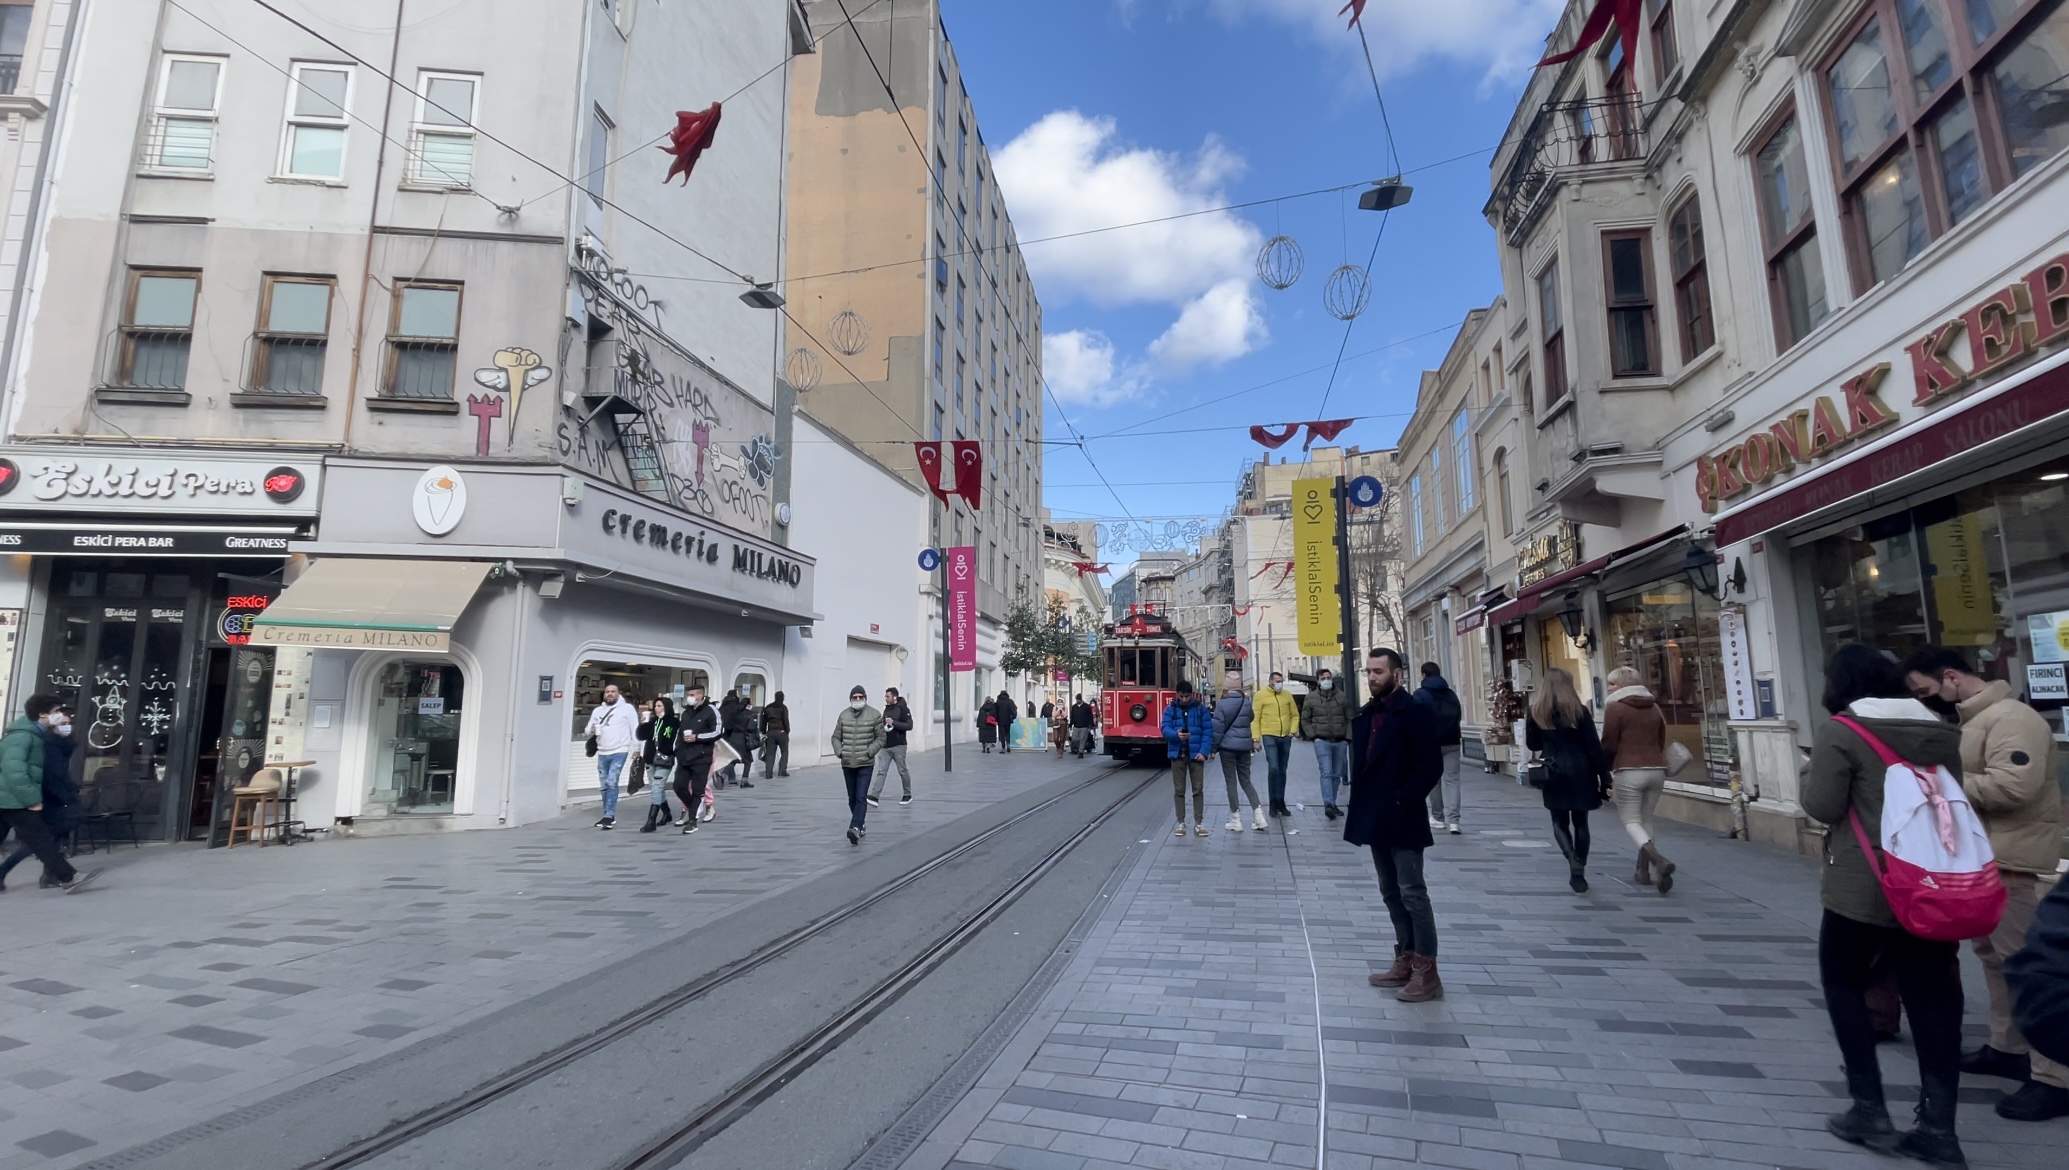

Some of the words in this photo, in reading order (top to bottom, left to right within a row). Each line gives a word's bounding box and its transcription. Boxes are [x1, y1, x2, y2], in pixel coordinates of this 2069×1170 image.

[1713, 361, 1900, 501] KONAK
[1804, 474, 1855, 512] KONAK
[1869, 443, 1925, 485] KEBAP
[1943, 399, 2030, 455] SALONU
[30, 459, 178, 500] Eskici
[181, 472, 255, 498] Pera
[74, 534, 112, 547] ESKİCİ
[115, 537, 146, 547] PERA
[149, 538, 173, 548] BAR
[226, 536, 286, 548] GREATNESS
[602, 508, 720, 565] cremeria
[733, 543, 801, 588] MILANO
[227, 635, 251, 645] BA
[263, 626, 353, 644] Cremeria
[363, 632, 438, 647] MILANO
[2030, 667, 2063, 679] FIRINCI
